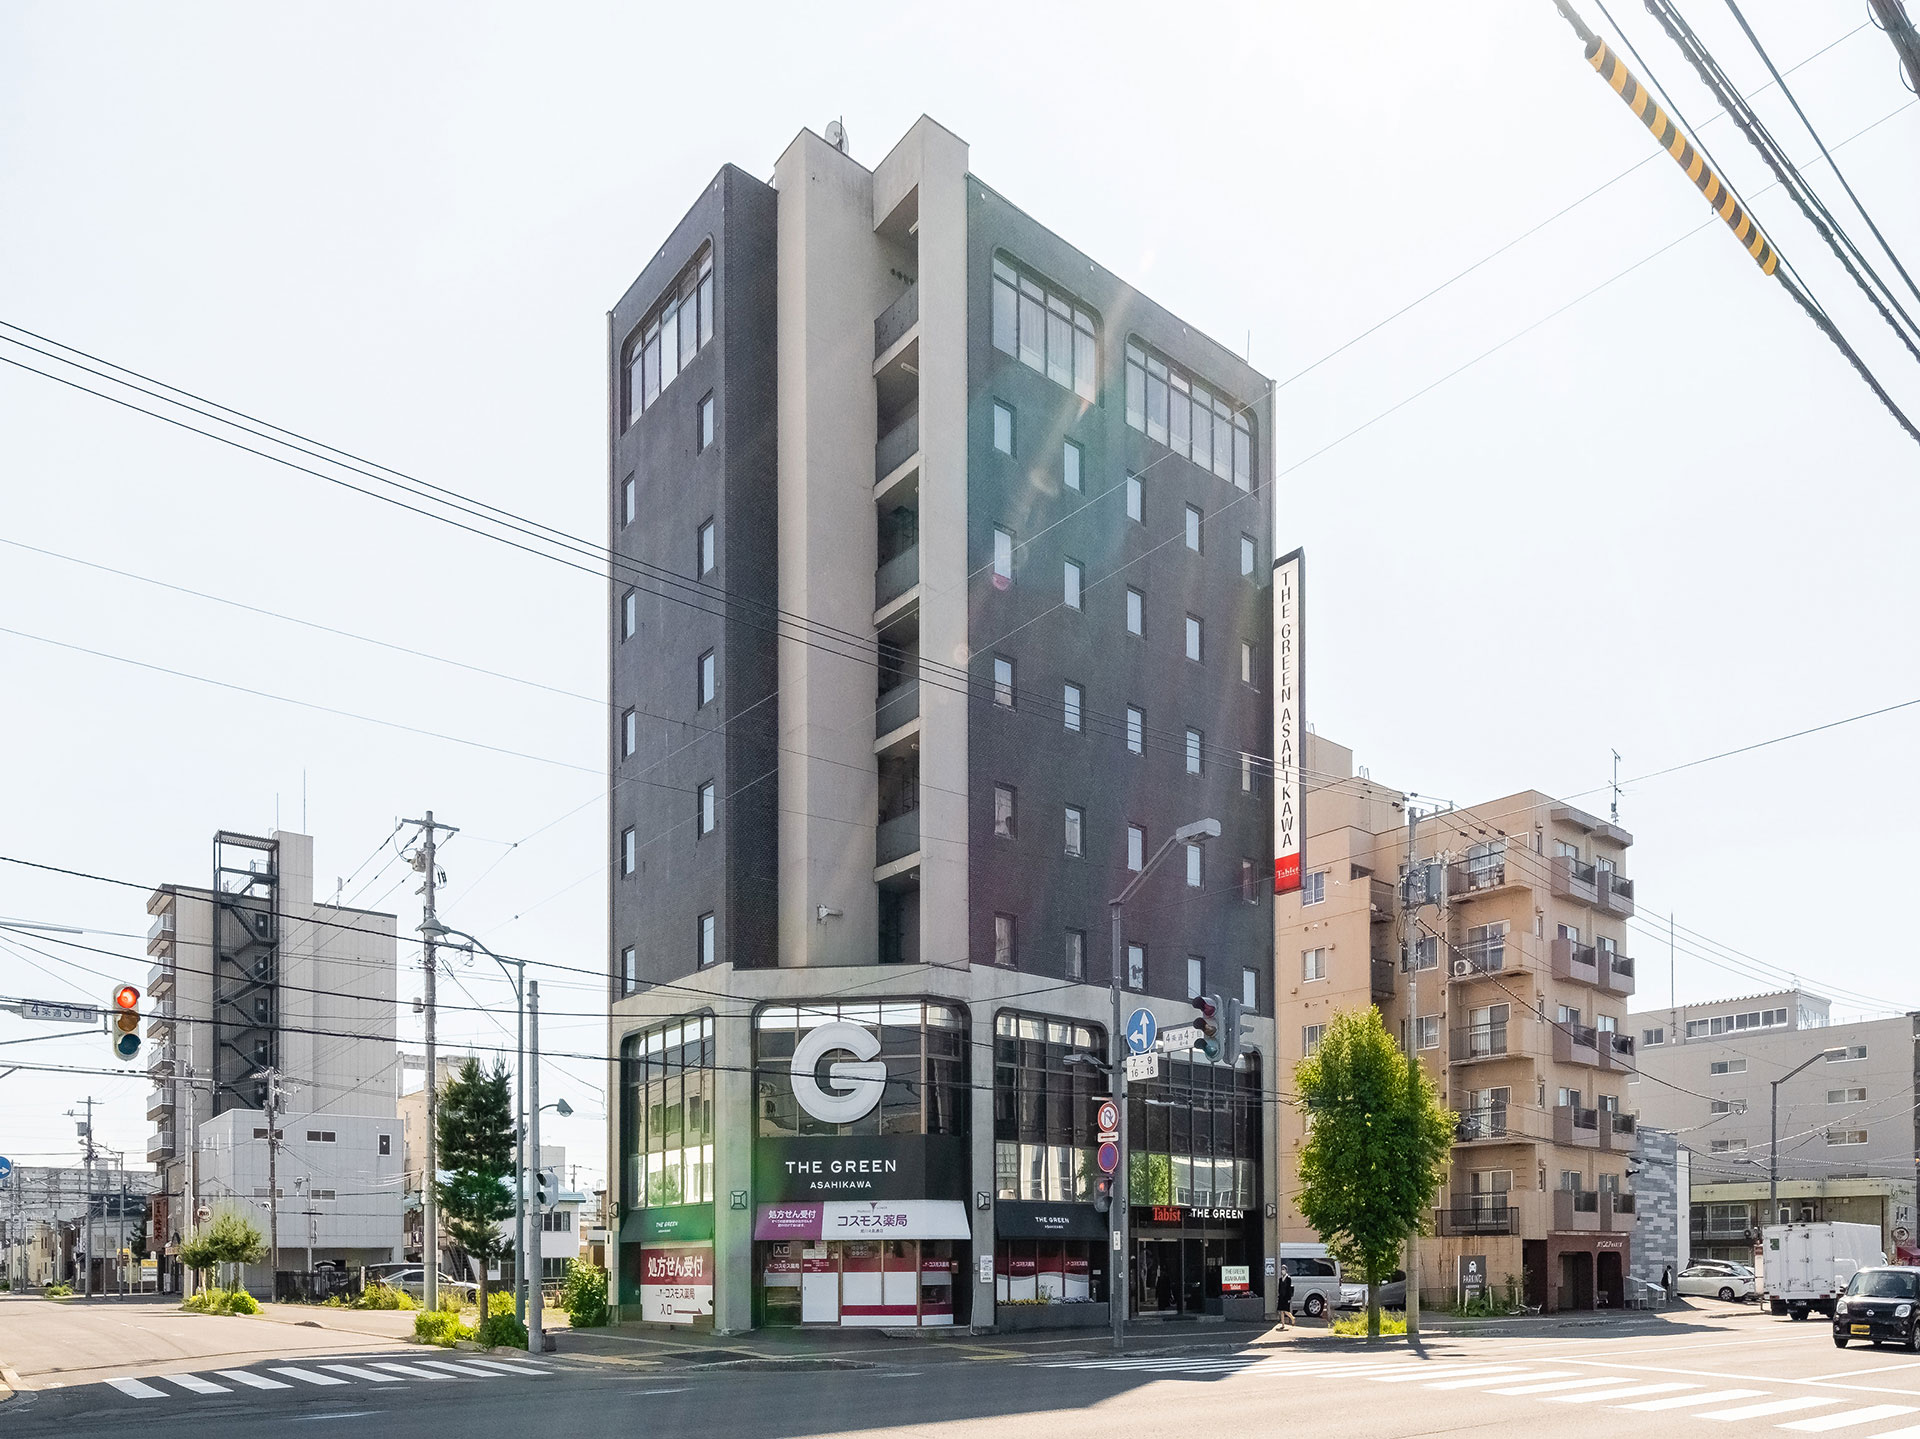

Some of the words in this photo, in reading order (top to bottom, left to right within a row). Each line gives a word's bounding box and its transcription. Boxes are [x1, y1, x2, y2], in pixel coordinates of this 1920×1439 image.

[1281, 571, 1291, 619] THE
[1281, 623, 1292, 704] GREEN
[1280, 707, 1293, 850] ASAHIKAWA
[791, 1021, 887, 1124] G
[785, 1161, 823, 1174] THE
[830, 1159, 897, 1173] GREEN
[810, 1180, 872, 1189] ASAHIKAWA
[768, 1209, 817, 1219] 処方せん受付
[837, 1214, 908, 1227] コスモス薬局
[1153, 1206, 1181, 1221] Tabist
[1191, 1208, 1210, 1219] THE
[1212, 1208, 1244, 1219] GREEN
[648, 1256, 704, 1278] 処方せん受付
[660, 1303, 673, 1316] 入口
